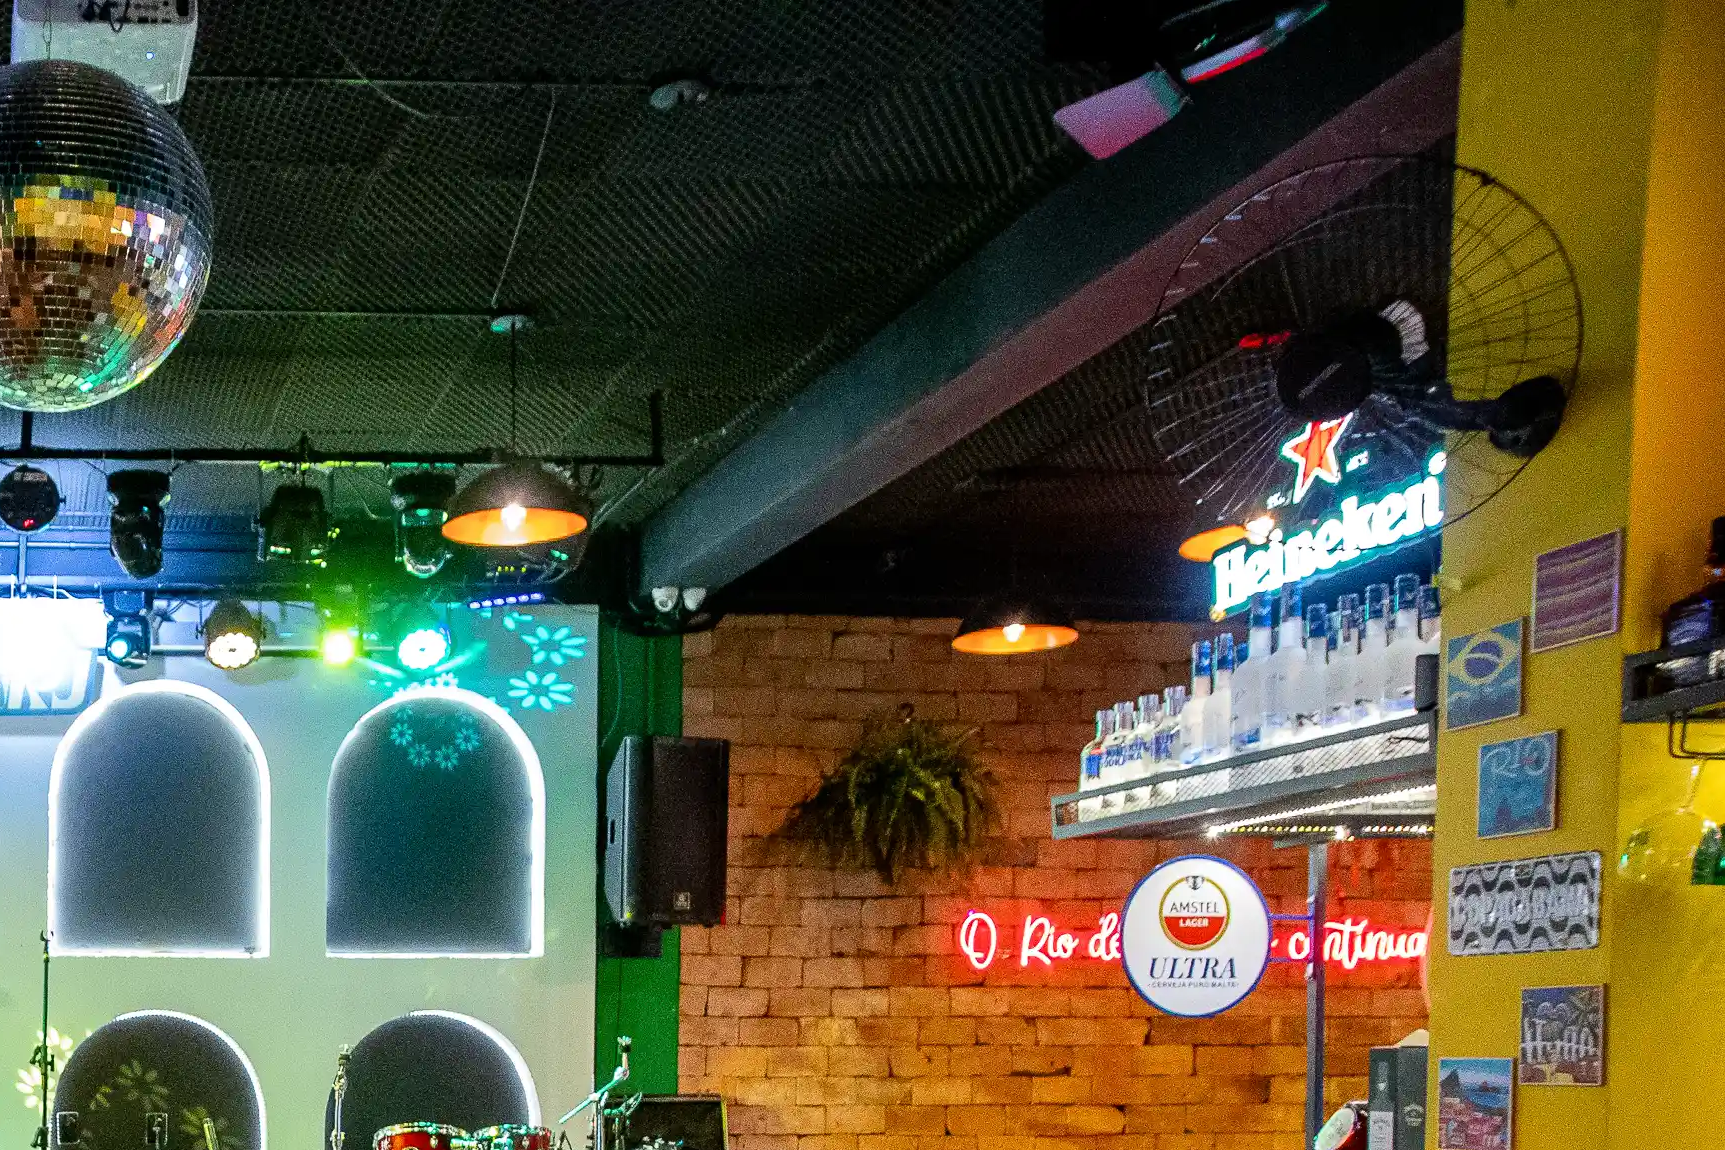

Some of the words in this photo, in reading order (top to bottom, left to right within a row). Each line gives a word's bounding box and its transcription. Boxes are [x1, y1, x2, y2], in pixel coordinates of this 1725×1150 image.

[1213, 476, 1444, 612] Heineken
[1169, 901, 1219, 913] AMSTEL
[1179, 918, 1209, 928] LAGER
[1021, 914, 1078, 967] Rio
[1149, 956, 1238, 979] ULTRA
